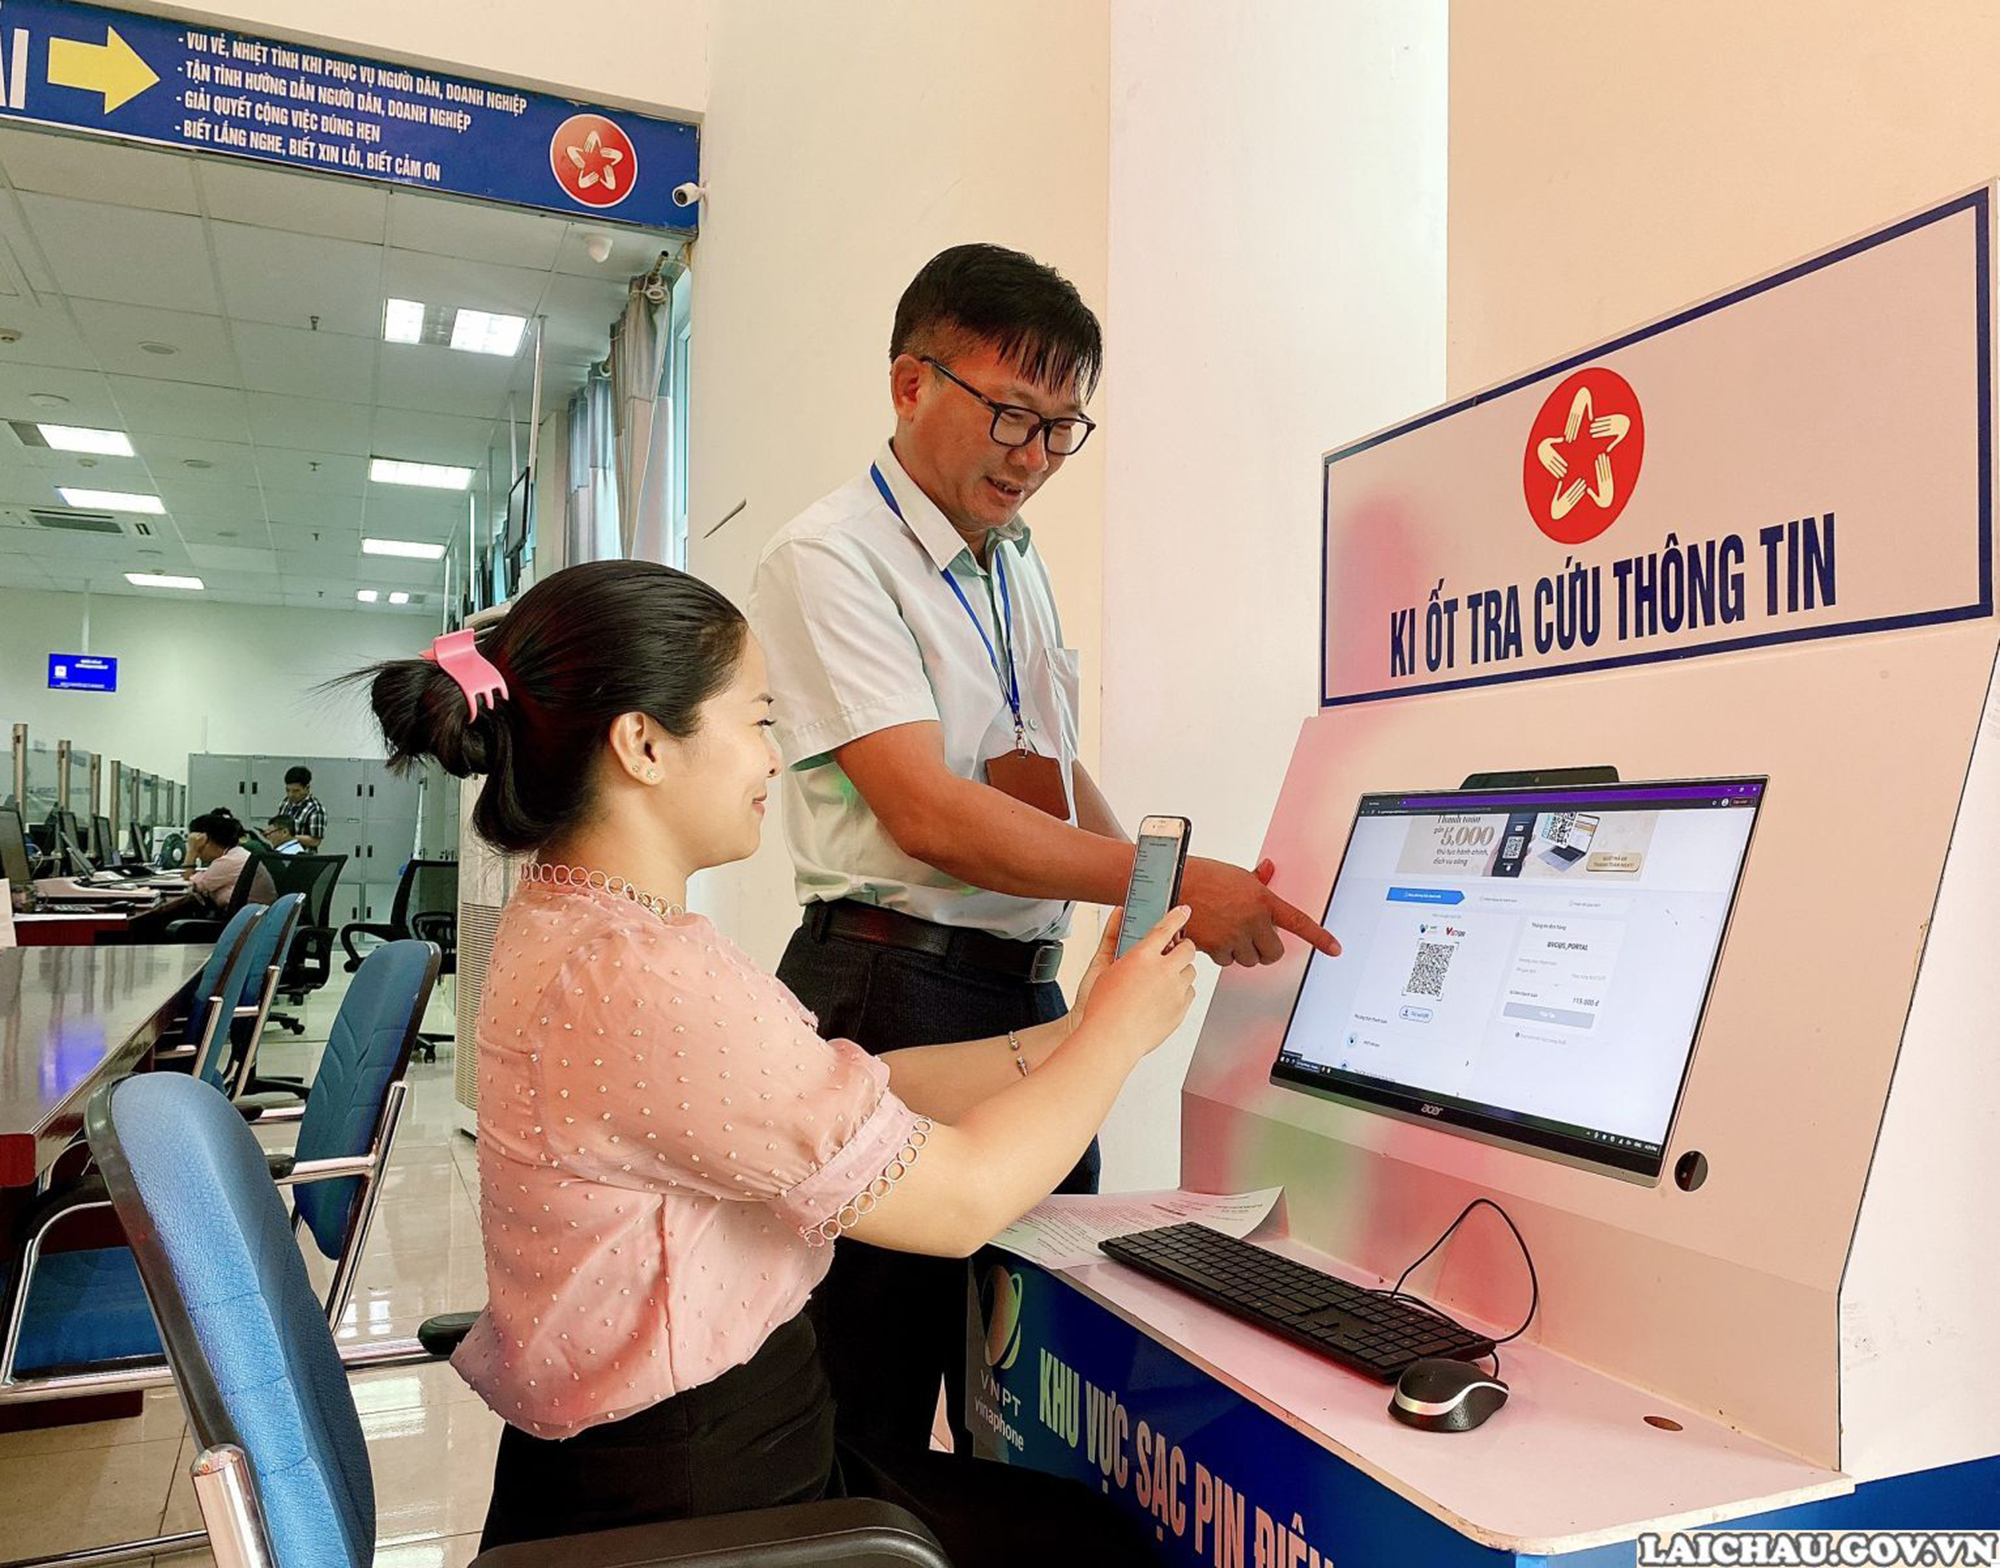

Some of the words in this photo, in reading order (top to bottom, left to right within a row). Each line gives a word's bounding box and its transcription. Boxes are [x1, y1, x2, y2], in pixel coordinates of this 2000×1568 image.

[186, 59, 211, 84] TẬN
[214, 63, 243, 88] TÌNH
[290, 76, 315, 102] DẪN
[318, 86, 354, 110] NGƯỜI
[357, 92, 385, 117] DÂN,
[388, 99, 427, 123] DOANH
[429, 109, 472, 133] NGHIỆP
[187, 31, 207, 52] VUI
[233, 41, 268, 66] NHIỆT
[271, 46, 299, 70] TÌNH
[302, 54, 322, 75] KHI
[325, 59, 357, 83] PHỤC
[360, 65, 375, 87] VỤ
[378, 69, 414, 93] NGƯỜI
[416, 76, 443, 100] DÂN,
[446, 83, 484, 106] DOANH
[487, 91, 528, 117] NGHIỆP
[183, 117, 212, 141] BIẾT
[249, 131, 287, 156] NGHE,
[289, 136, 316, 159] BIẾT
[318, 143, 339, 164] XIN
[367, 150, 393, 173] BIẾT
[395, 154, 421, 178] CẢM
[424, 161, 441, 181] ƠN
[185, 87, 211, 112] GIẢI
[213, 95, 252, 119] QUYẾT
[291, 109, 318, 133] VIỆC
[321, 114, 353, 138] ĐÚNG
[356, 122, 381, 144] HẸN
[1390, 608, 1416, 678] KI
[1425, 577, 1458, 673] ỐT
[1466, 584, 1523, 665] TRA
[1533, 555, 1601, 655] CỨU
[1612, 532, 1745, 641] THÔNG
[1759, 512, 1836, 617] TIN
[1421, 1103, 1443, 1116] acer
[980, 1368, 1021, 1417] VNPT
[1039, 1347, 1080, 1449] KHU
[1085, 1380, 1129, 1494] VỰC
[1135, 1420, 1187, 1542] SẠC
[1194, 1461, 1245, 1568] PIN
